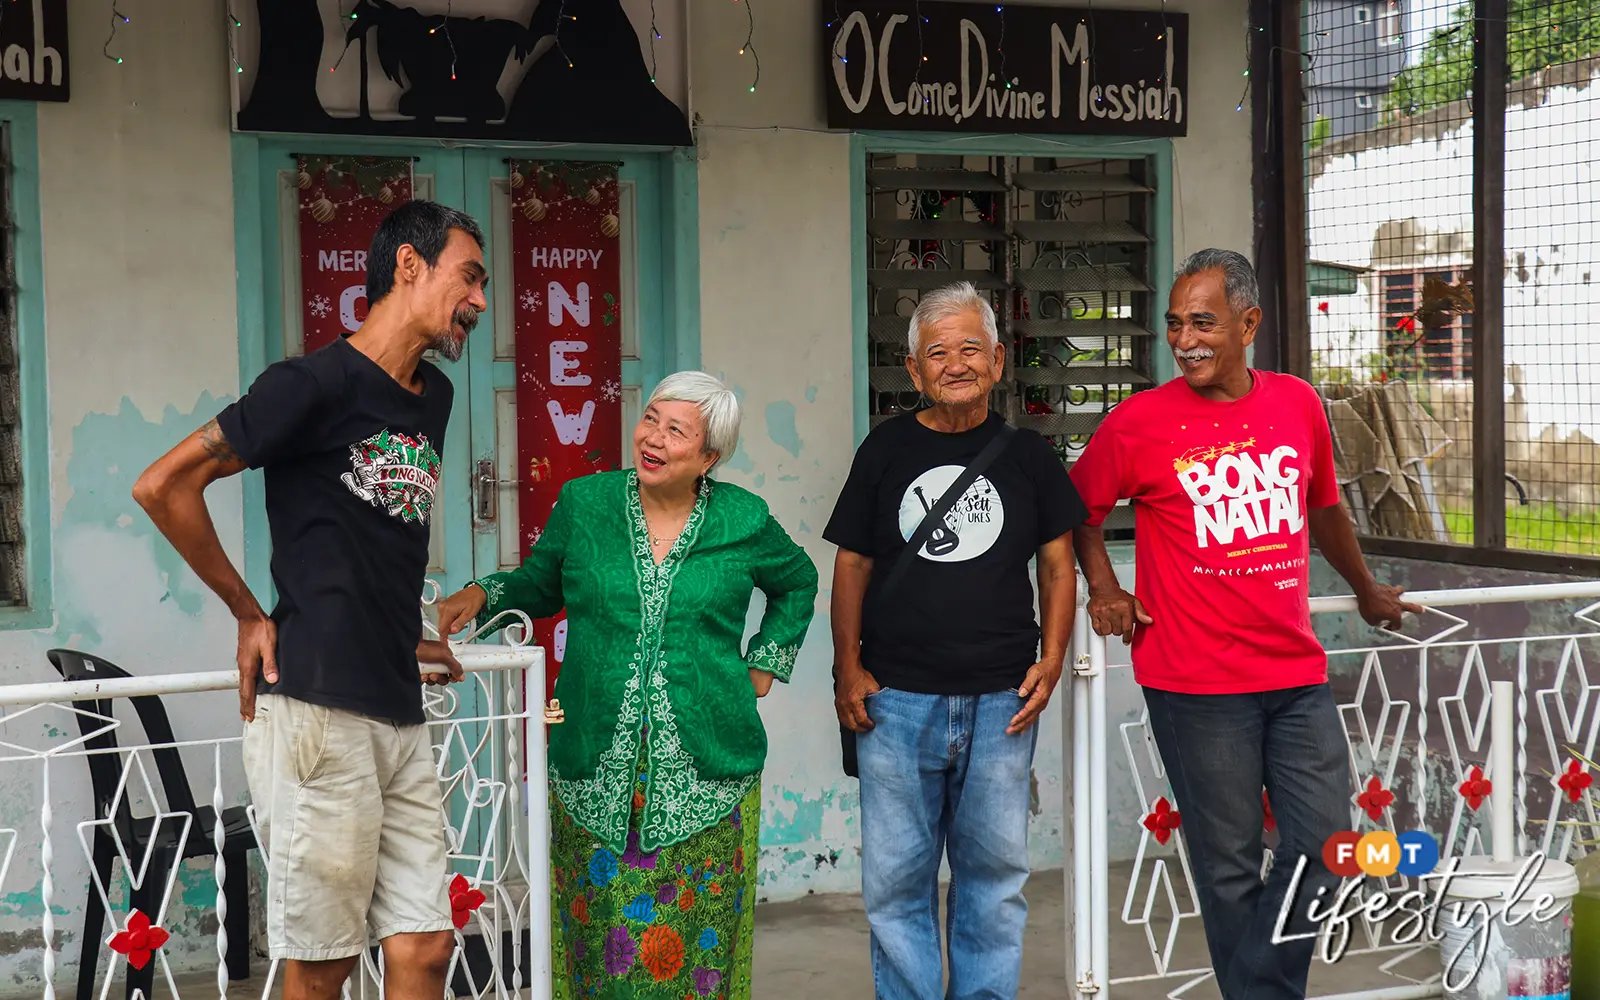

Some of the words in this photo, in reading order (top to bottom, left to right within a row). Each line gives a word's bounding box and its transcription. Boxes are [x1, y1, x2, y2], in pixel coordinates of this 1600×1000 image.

[832, 10, 875, 114] O
[960, 18, 1046, 119] Divine
[1051, 23, 1182, 124] Messiah
[318, 249, 367, 272] MER
[532, 247, 603, 269] HAPPY
[380, 467, 415, 481] BONG
[1177, 445, 1299, 506] BONG
[968, 512, 991, 523] UKES
[1193, 485, 1304, 548] NATAL
[1227, 548, 1251, 558] MERRY
[1252, 543, 1288, 553] CHRISTMAS
